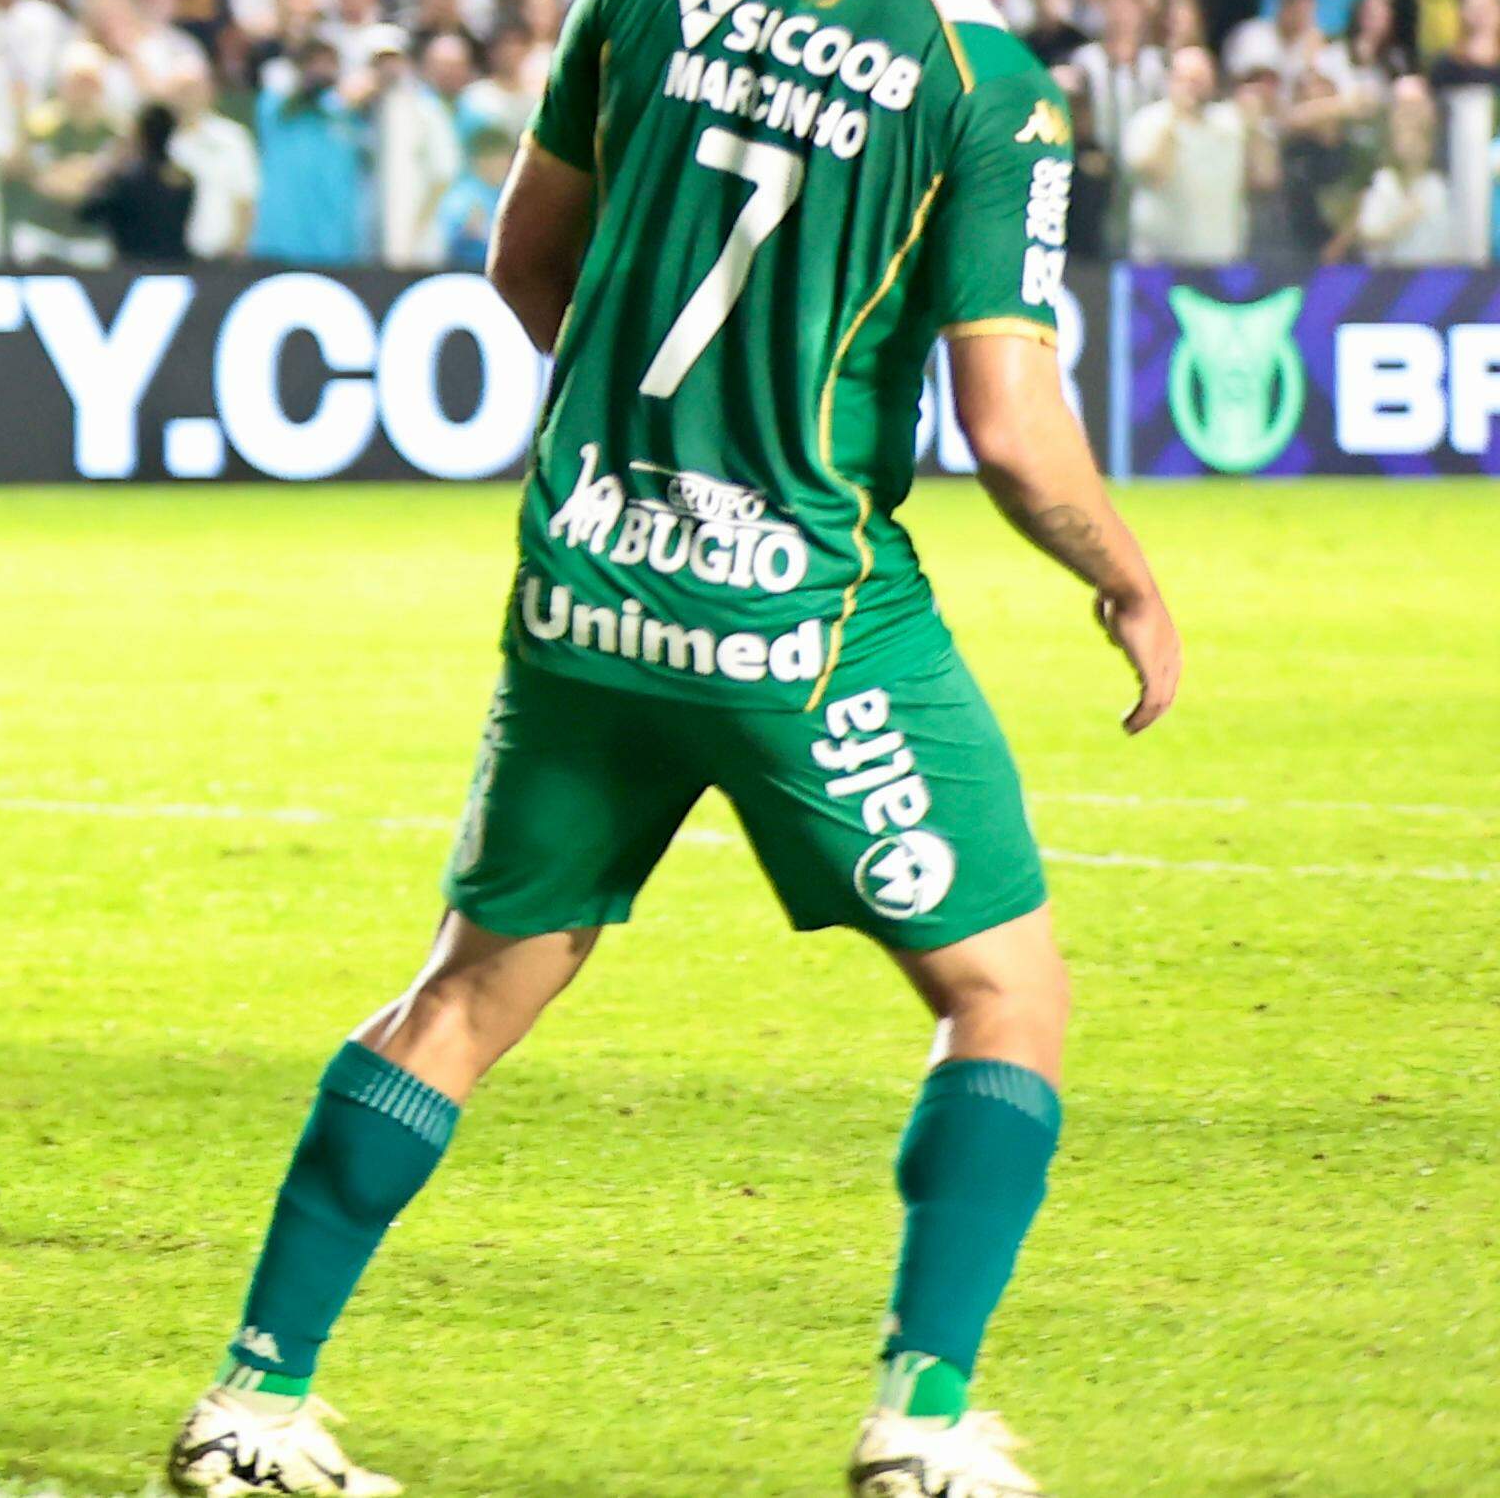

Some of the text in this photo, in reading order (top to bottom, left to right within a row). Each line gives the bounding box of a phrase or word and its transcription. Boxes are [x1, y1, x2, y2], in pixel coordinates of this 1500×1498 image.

[724, 1, 923, 111] SICOOB
[638, 127, 804, 399] 7
[609, 506, 808, 594] BUGIO
[521, 576, 823, 683] Unimed
[810, 688, 931, 836] alfa
